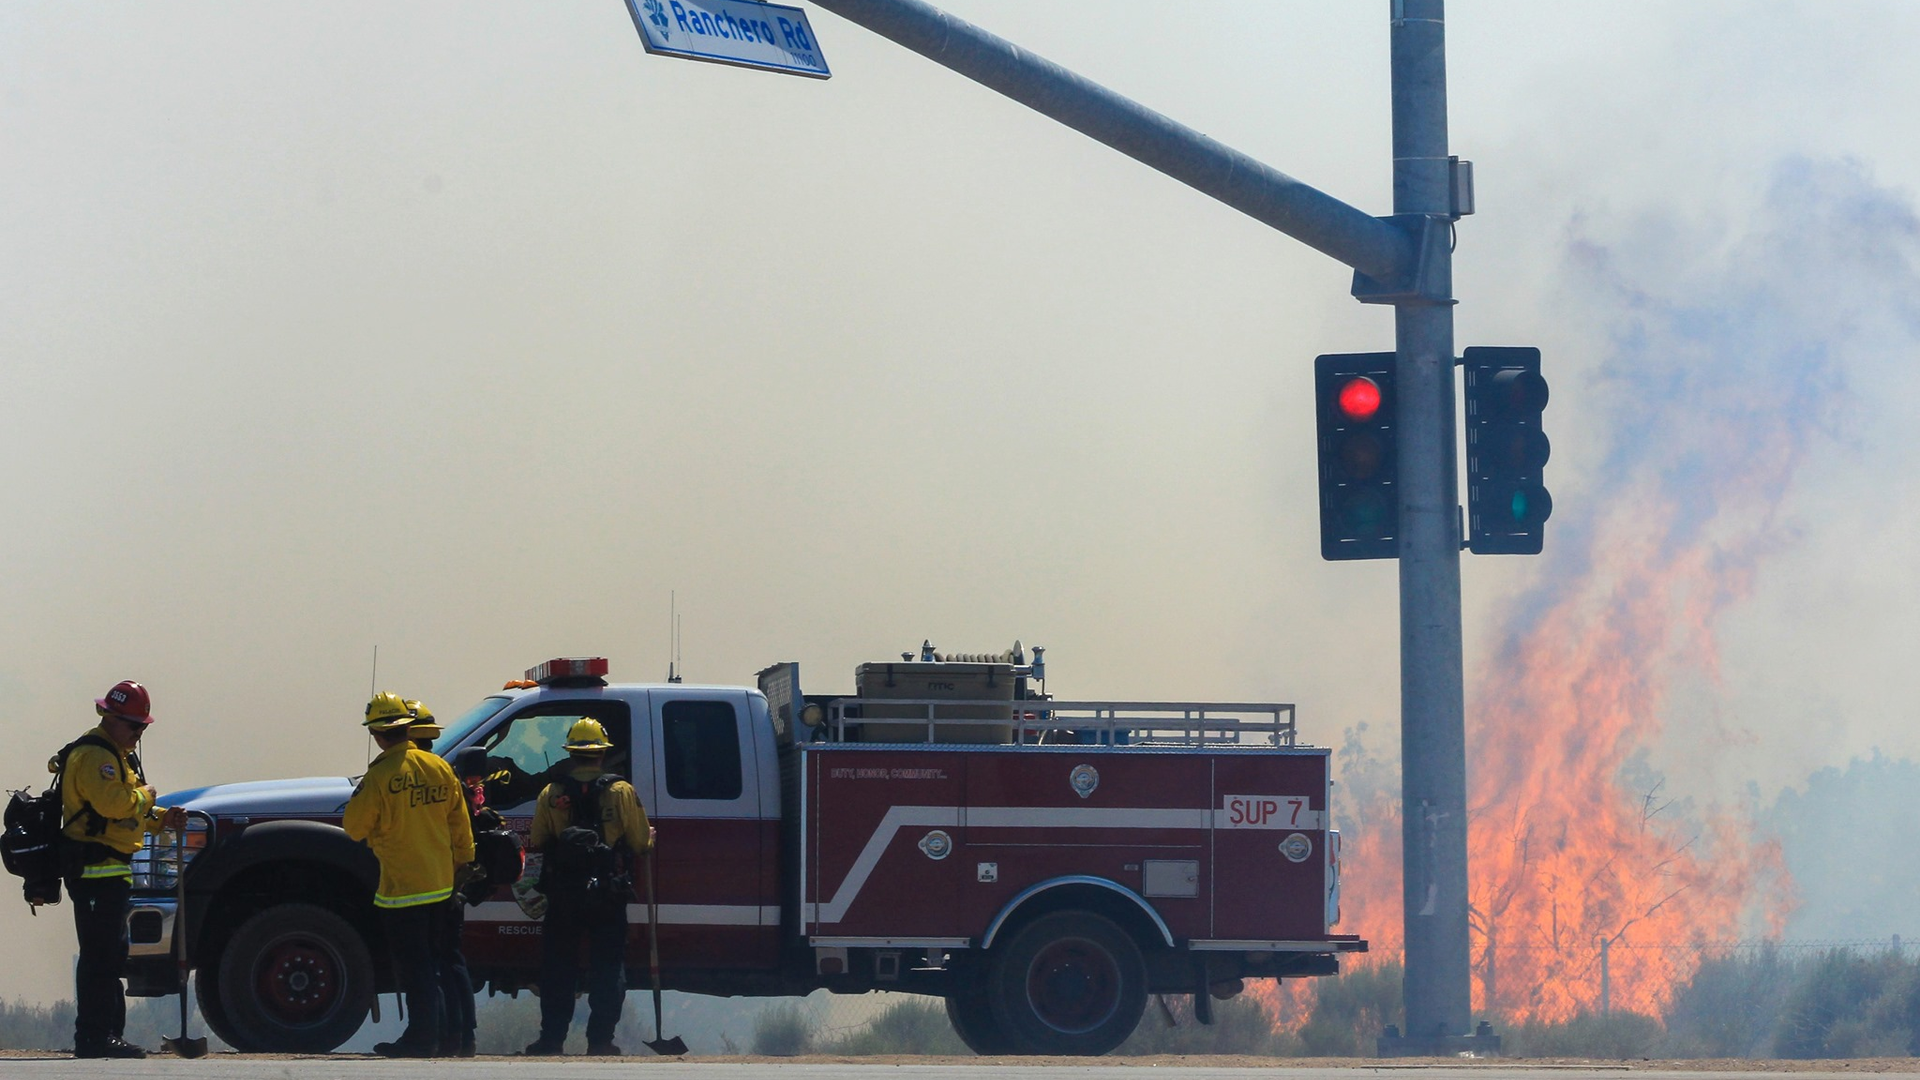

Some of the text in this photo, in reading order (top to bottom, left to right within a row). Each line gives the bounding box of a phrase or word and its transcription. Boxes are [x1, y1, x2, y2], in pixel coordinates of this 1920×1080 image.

[669, 0, 812, 51] Ranchero Rd
[388, 770, 426, 794] CAL
[831, 767, 855, 780] DUTY,
[856, 767, 890, 780] HONOR,
[410, 784, 448, 807] FIRE
[1229, 799, 1303, 825] SUP 7
[498, 925, 543, 935] RESCUE
